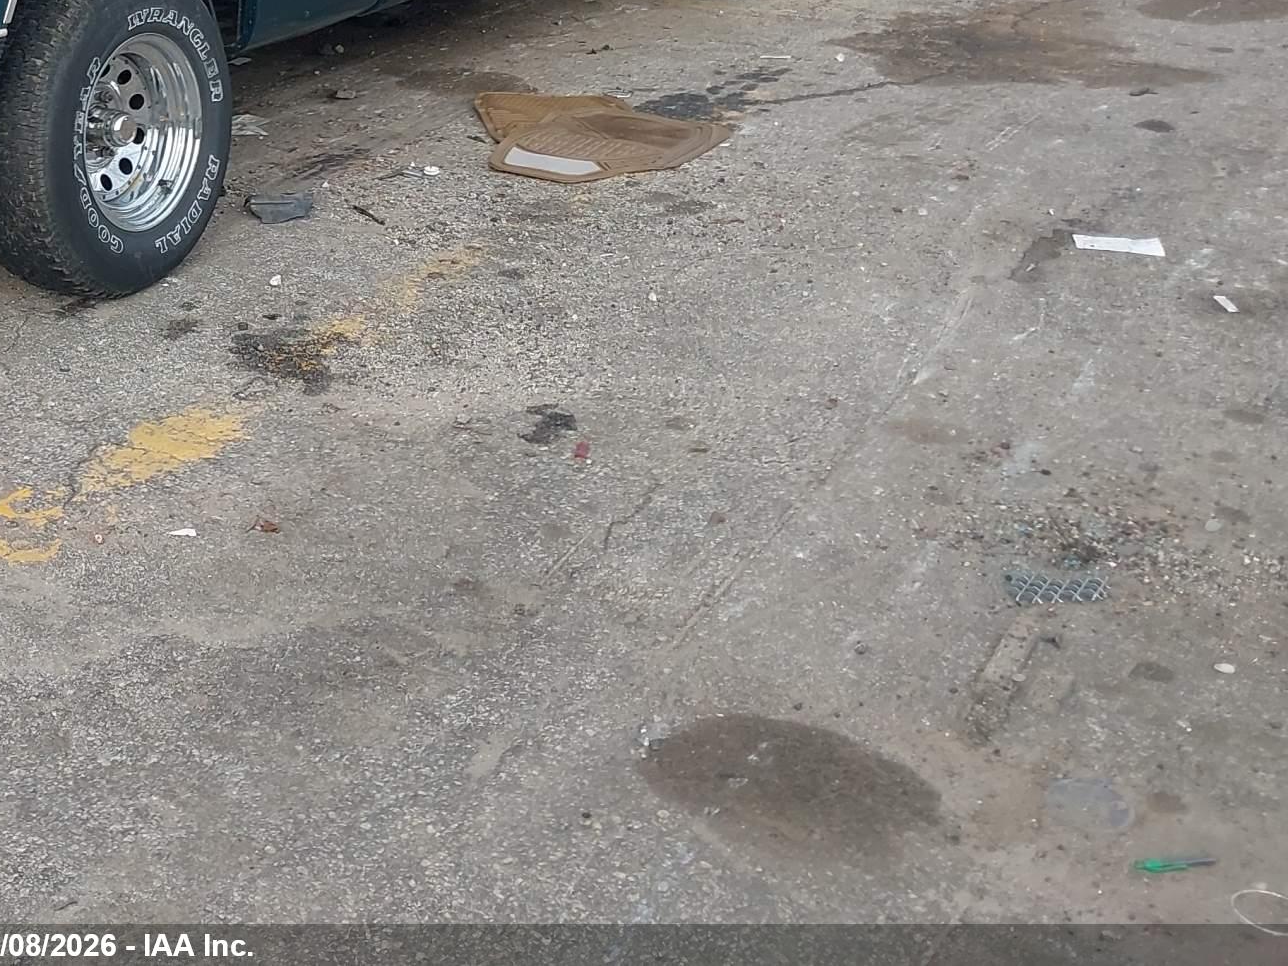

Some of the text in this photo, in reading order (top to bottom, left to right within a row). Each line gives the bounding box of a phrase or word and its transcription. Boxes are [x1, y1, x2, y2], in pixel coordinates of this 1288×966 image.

[127, 7, 224, 103] WRANGLER
[73, 57, 125, 255] GOODYEAR
[155, 154, 221, 254] RADIAL
